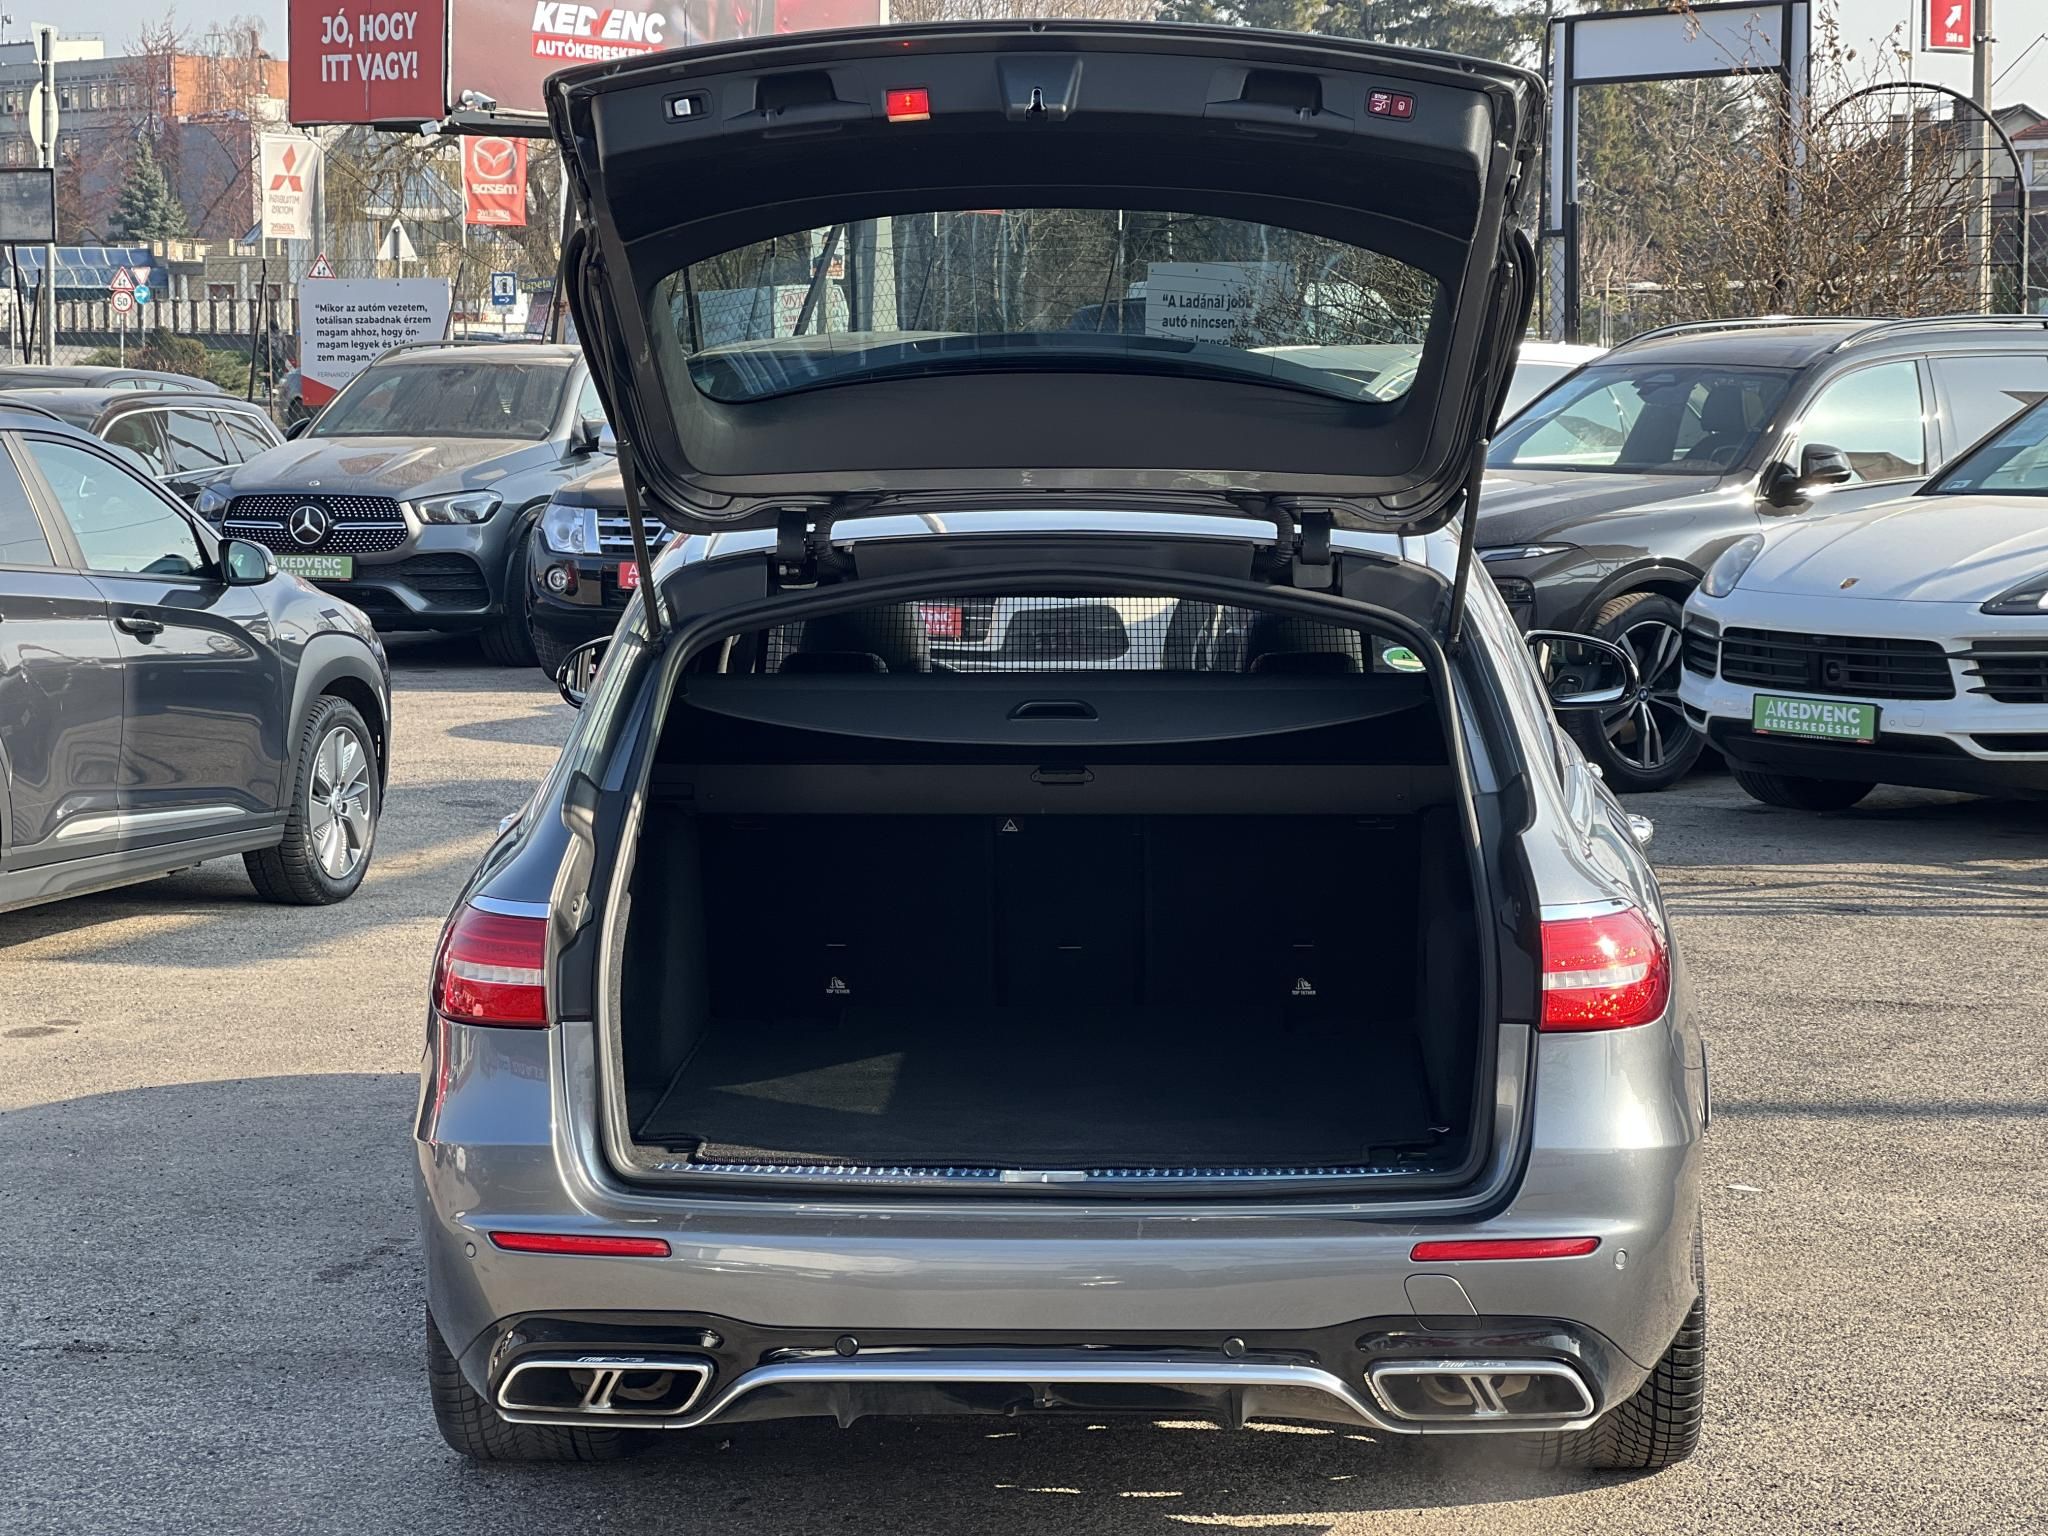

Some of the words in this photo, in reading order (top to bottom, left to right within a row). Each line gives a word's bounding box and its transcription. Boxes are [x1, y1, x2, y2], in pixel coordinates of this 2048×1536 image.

[321, 8, 354, 48] JÓ,
[359, 12, 418, 42] HOGY
[536, 38, 653, 60] AUTÓKERESKE
[321, 54, 353, 82] ITT
[356, 51, 418, 81] VAGY!
[117, 297, 128, 306] 50
[358, 303, 386, 312] autóm
[388, 304, 428, 313] vezetem,
[1180, 294, 1224, 309] Ladánál
[316, 315, 353, 324] totálisan
[355, 315, 401, 324] szabadnak
[403, 315, 431, 324] érzem
[1162, 314, 1188, 328] autó
[316, 329, 349, 338] magam
[351, 328, 379, 337] ahhoz,
[381, 327, 403, 338] hogy
[317, 341, 349, 350] magam
[351, 340, 380, 350] legyek
[382, 339, 392, 348] és
[317, 353, 335, 362] zem
[1765, 700, 1861, 724] AKEDVENC
[1764, 718, 1860, 736] KERESKEDÉSEM
